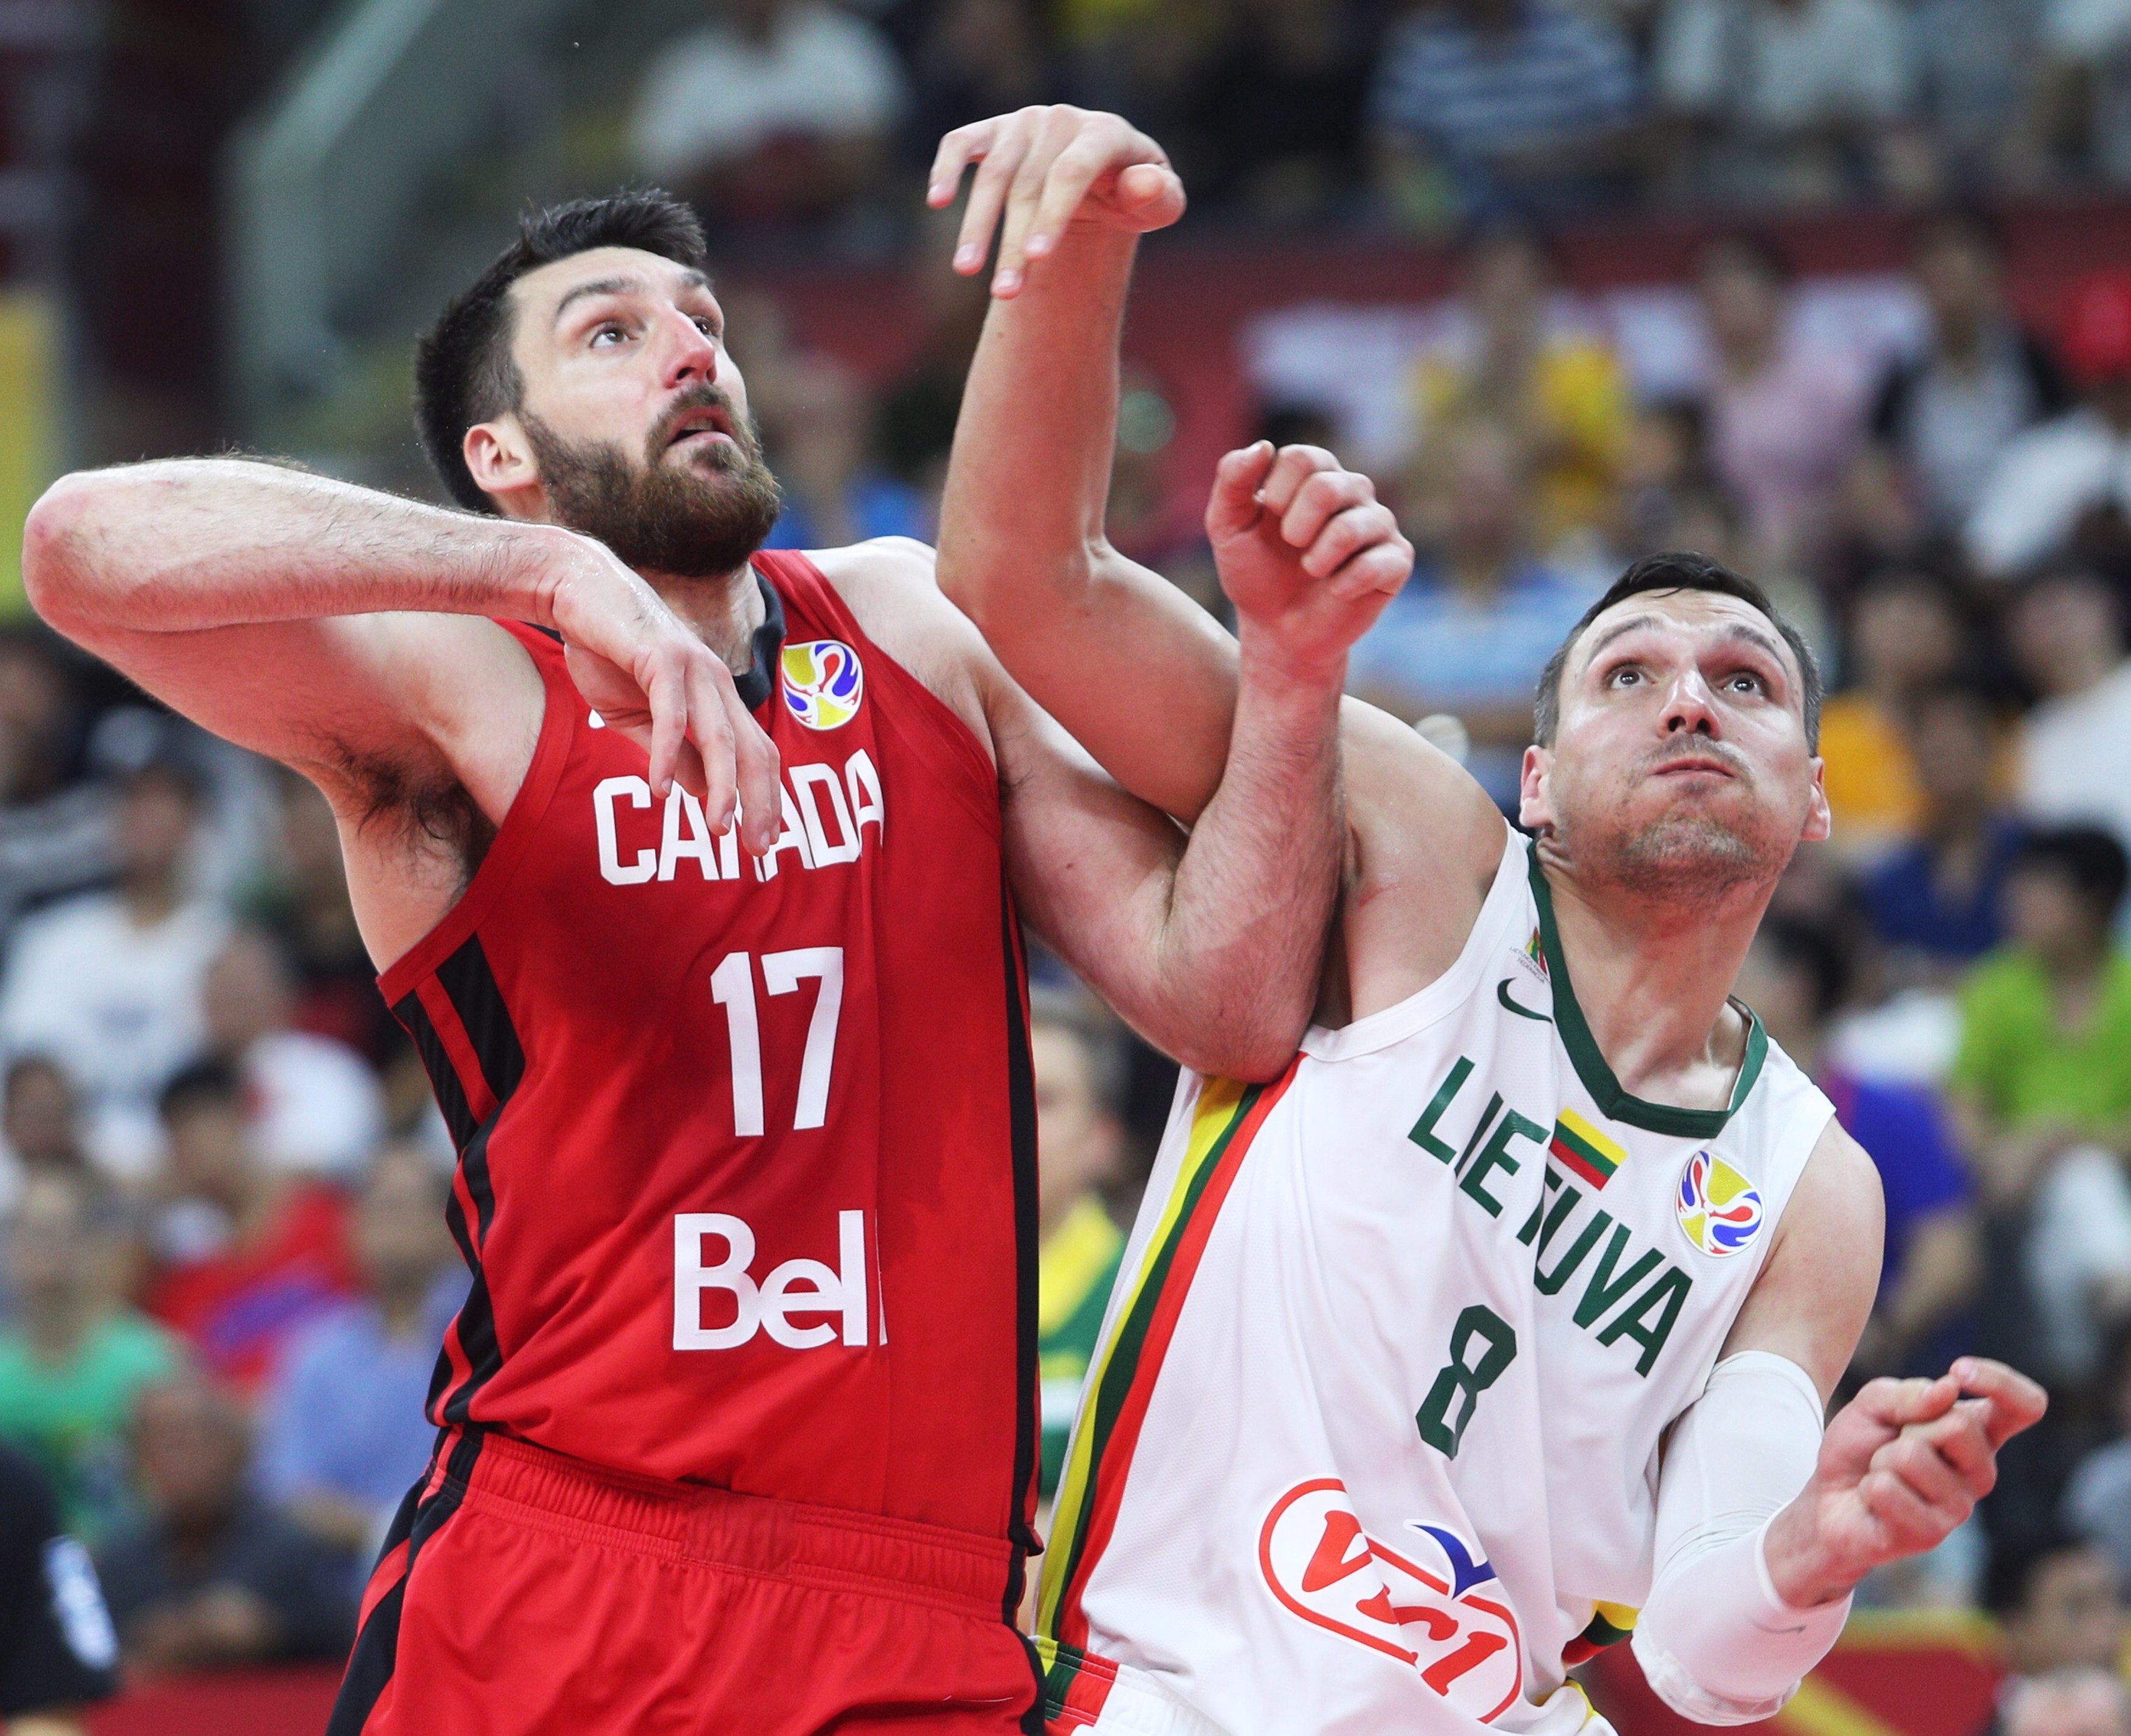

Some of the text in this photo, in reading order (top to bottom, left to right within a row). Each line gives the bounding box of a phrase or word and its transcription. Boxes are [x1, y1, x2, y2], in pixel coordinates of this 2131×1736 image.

[710, 946, 843, 1137] 17
[673, 1210, 888, 1350] Bel
[1416, 1304, 1517, 1461] 8
